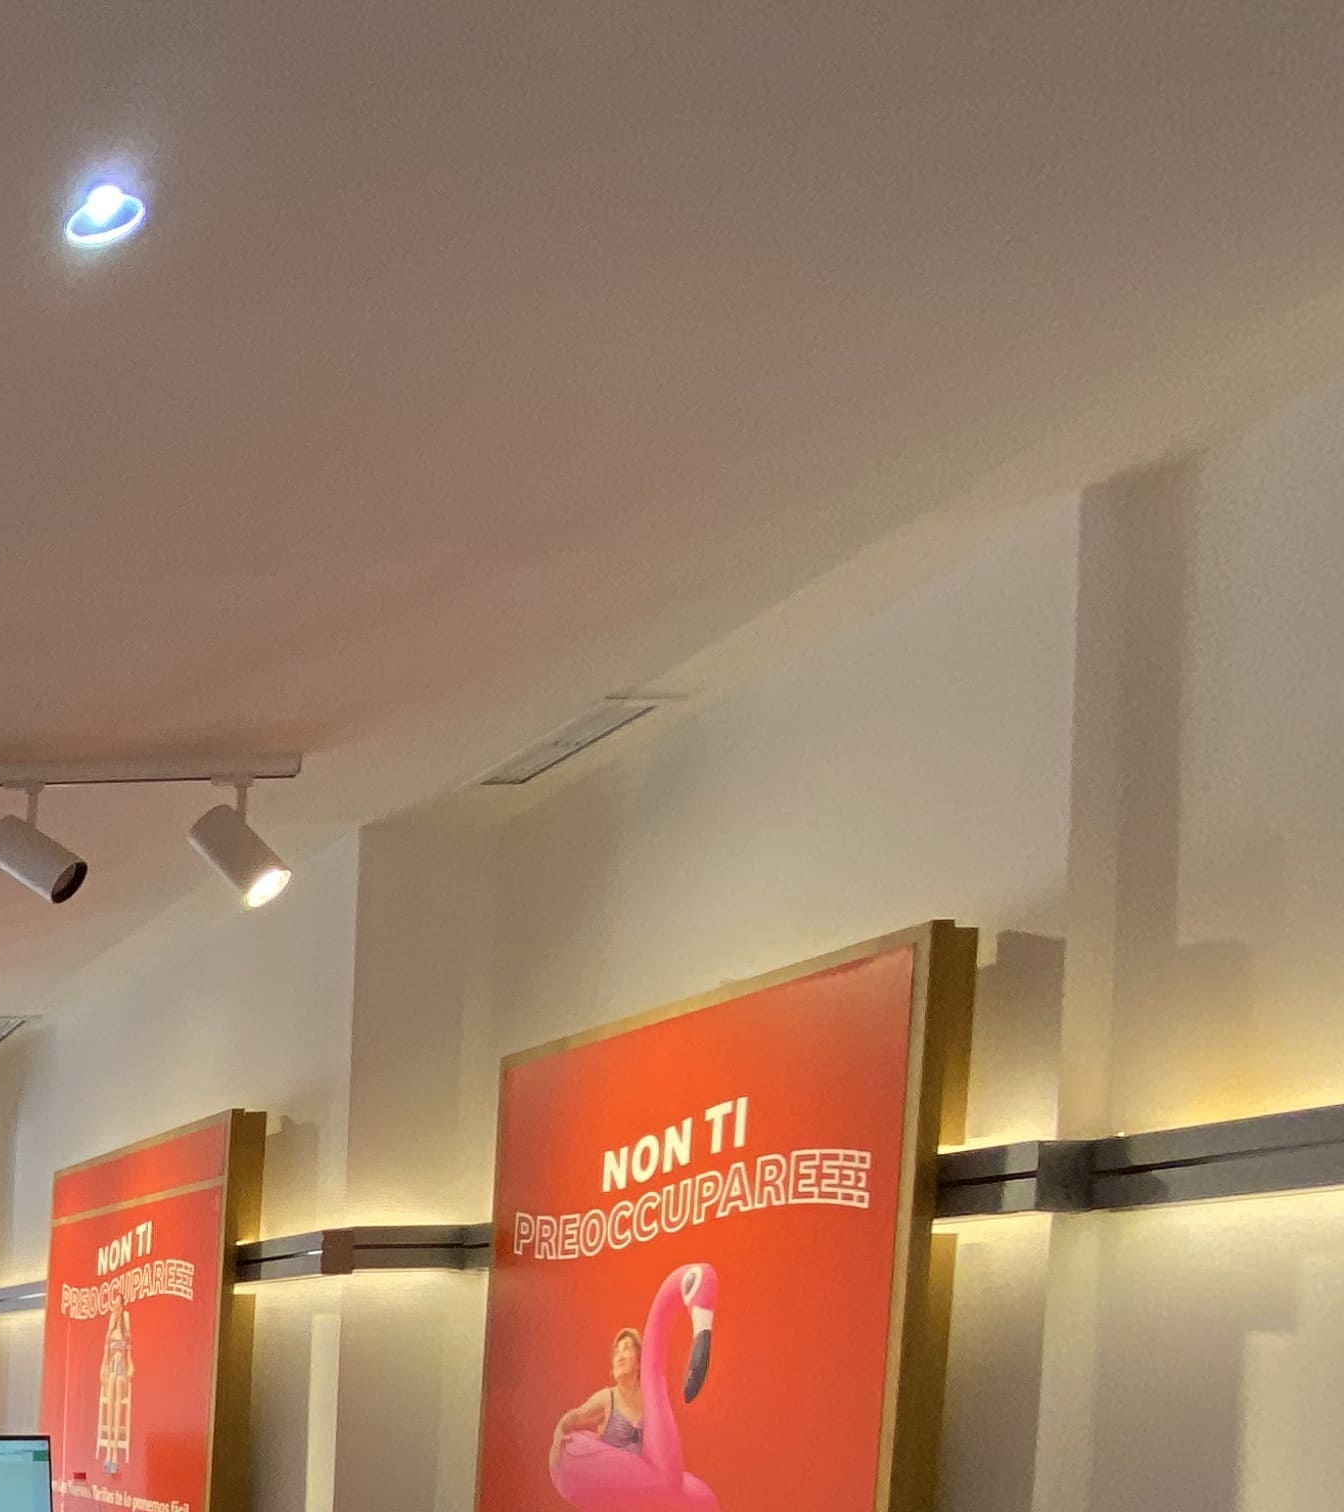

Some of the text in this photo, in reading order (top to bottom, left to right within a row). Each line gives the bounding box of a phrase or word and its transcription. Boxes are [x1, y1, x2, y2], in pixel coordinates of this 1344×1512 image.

[602, 1097, 748, 1192] NON TI
[97, 1220, 152, 1276] NON TI
